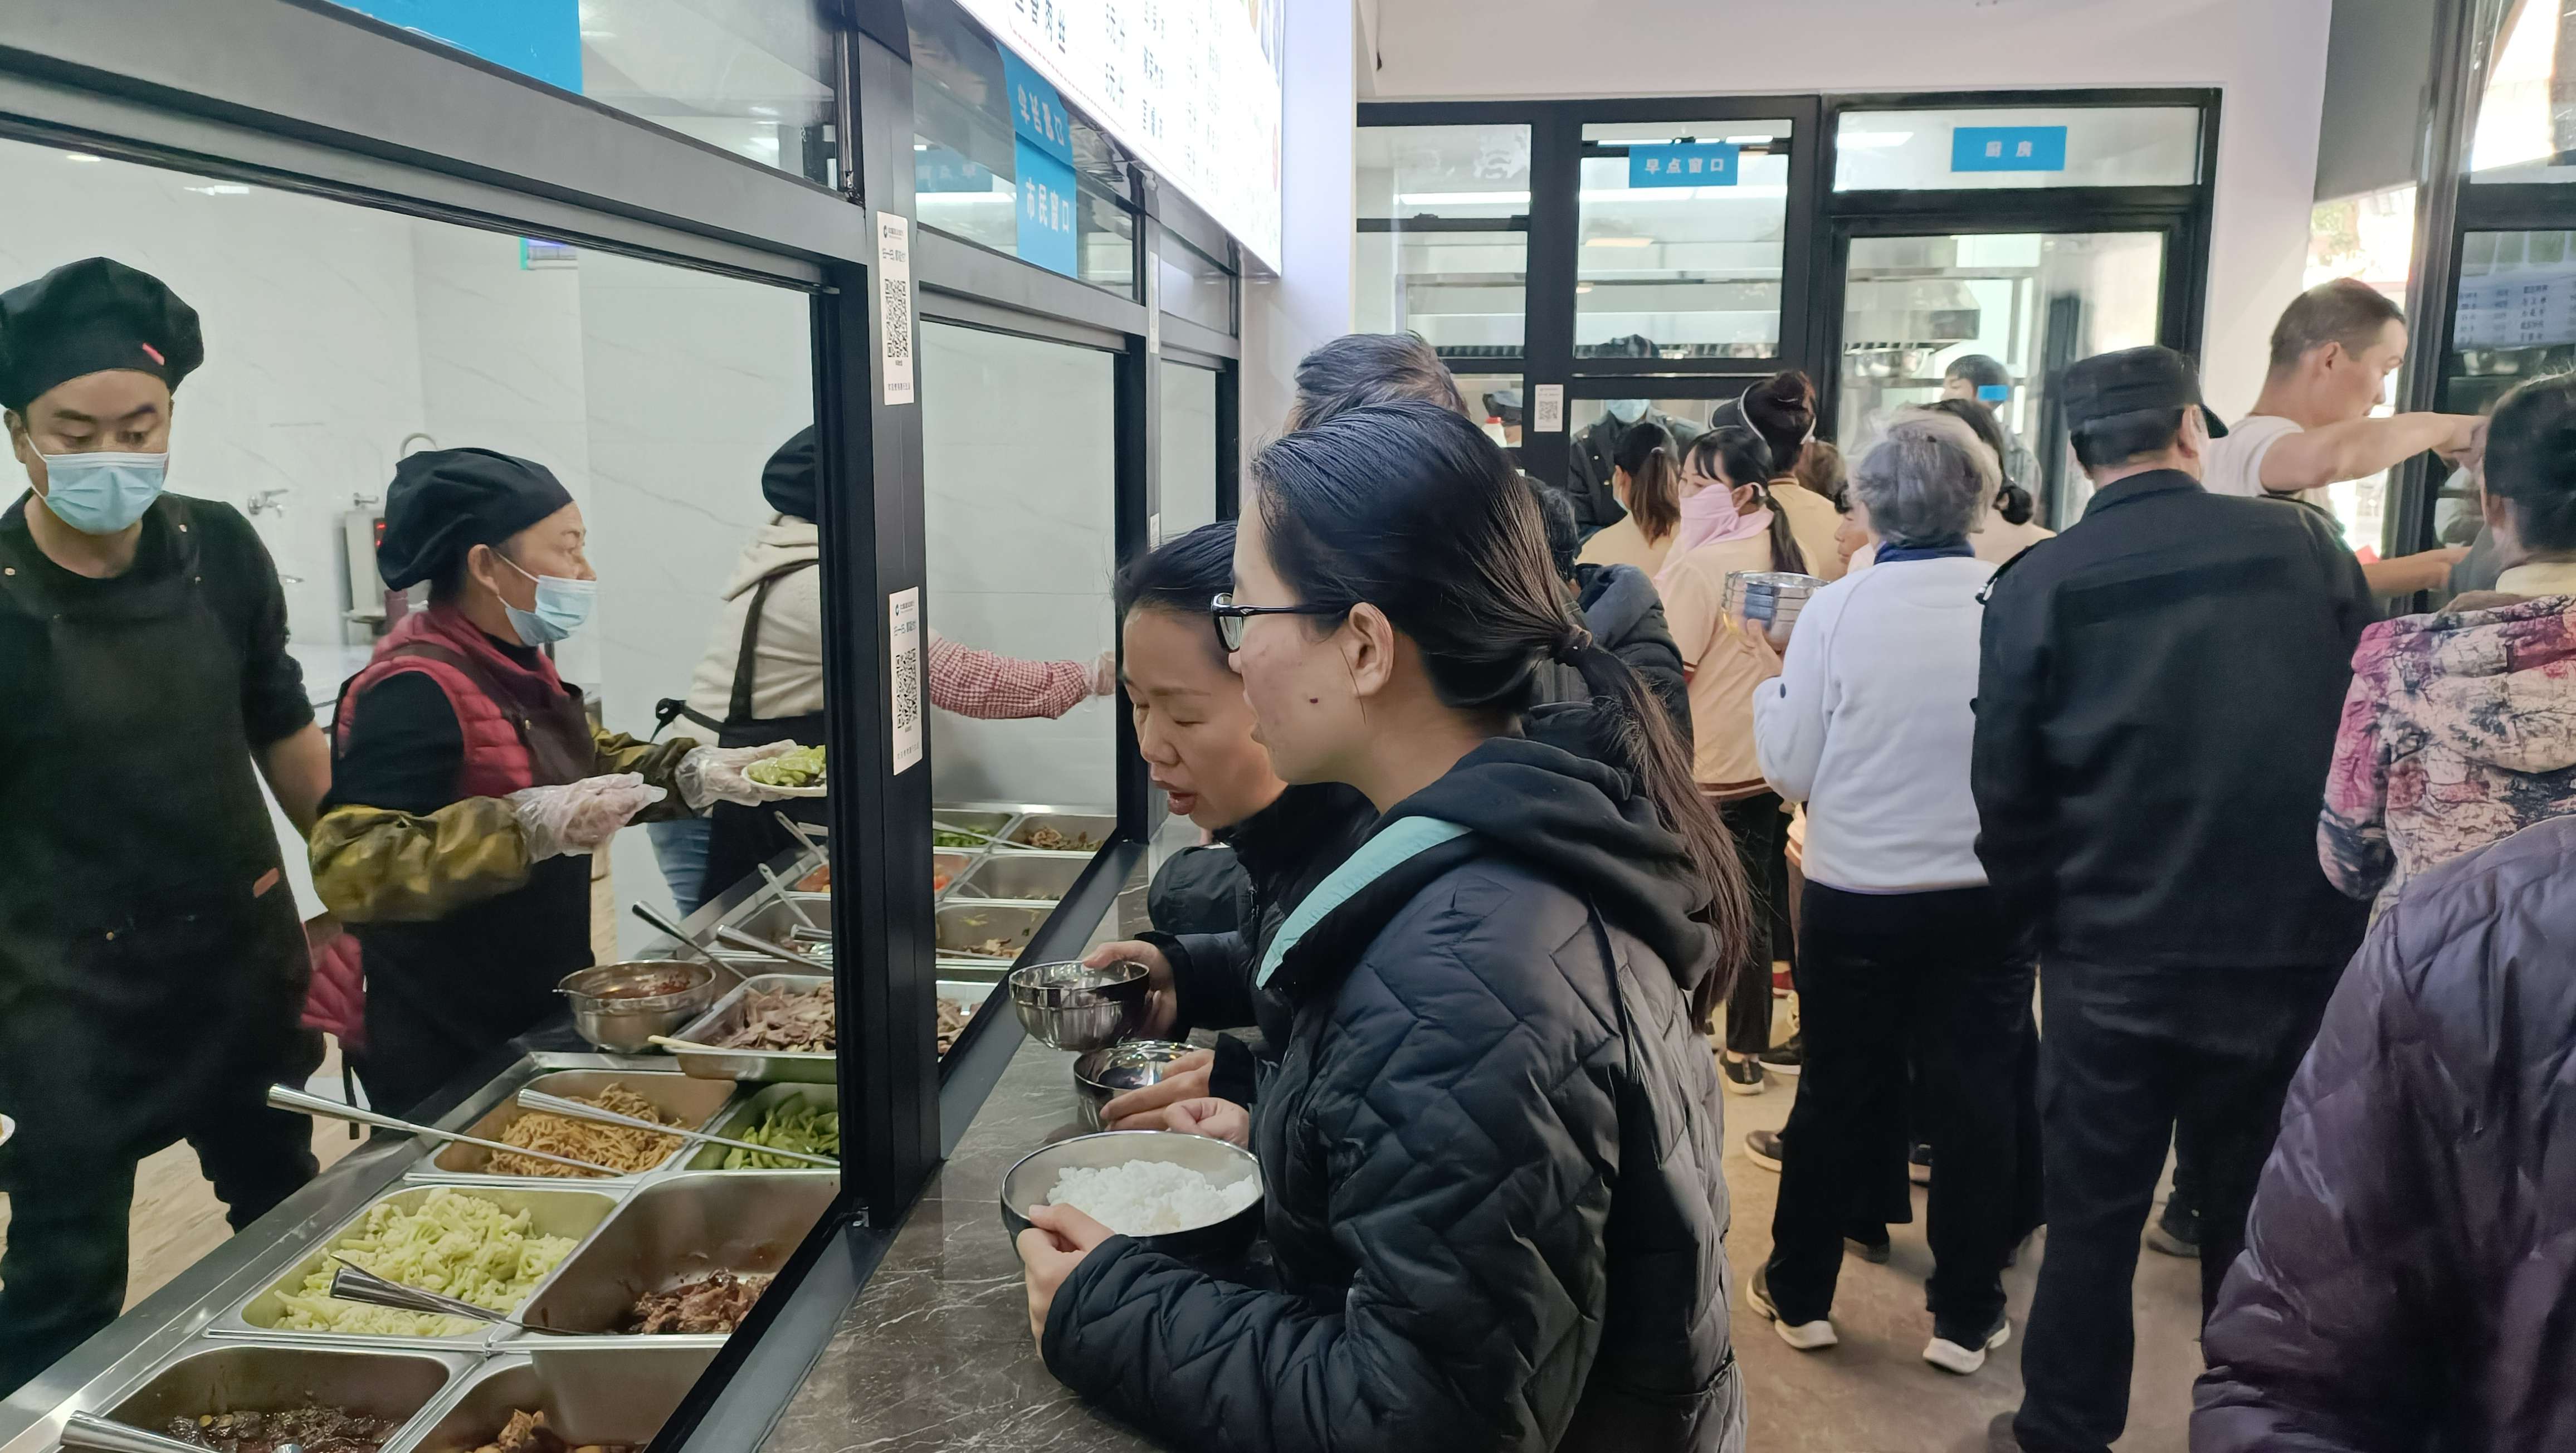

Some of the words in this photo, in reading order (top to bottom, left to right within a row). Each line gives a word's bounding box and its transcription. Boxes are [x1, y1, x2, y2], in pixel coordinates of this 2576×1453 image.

[1644, 157, 1725, 175] 早点窗口
[1025, 176, 1070, 234] 市民窗口
